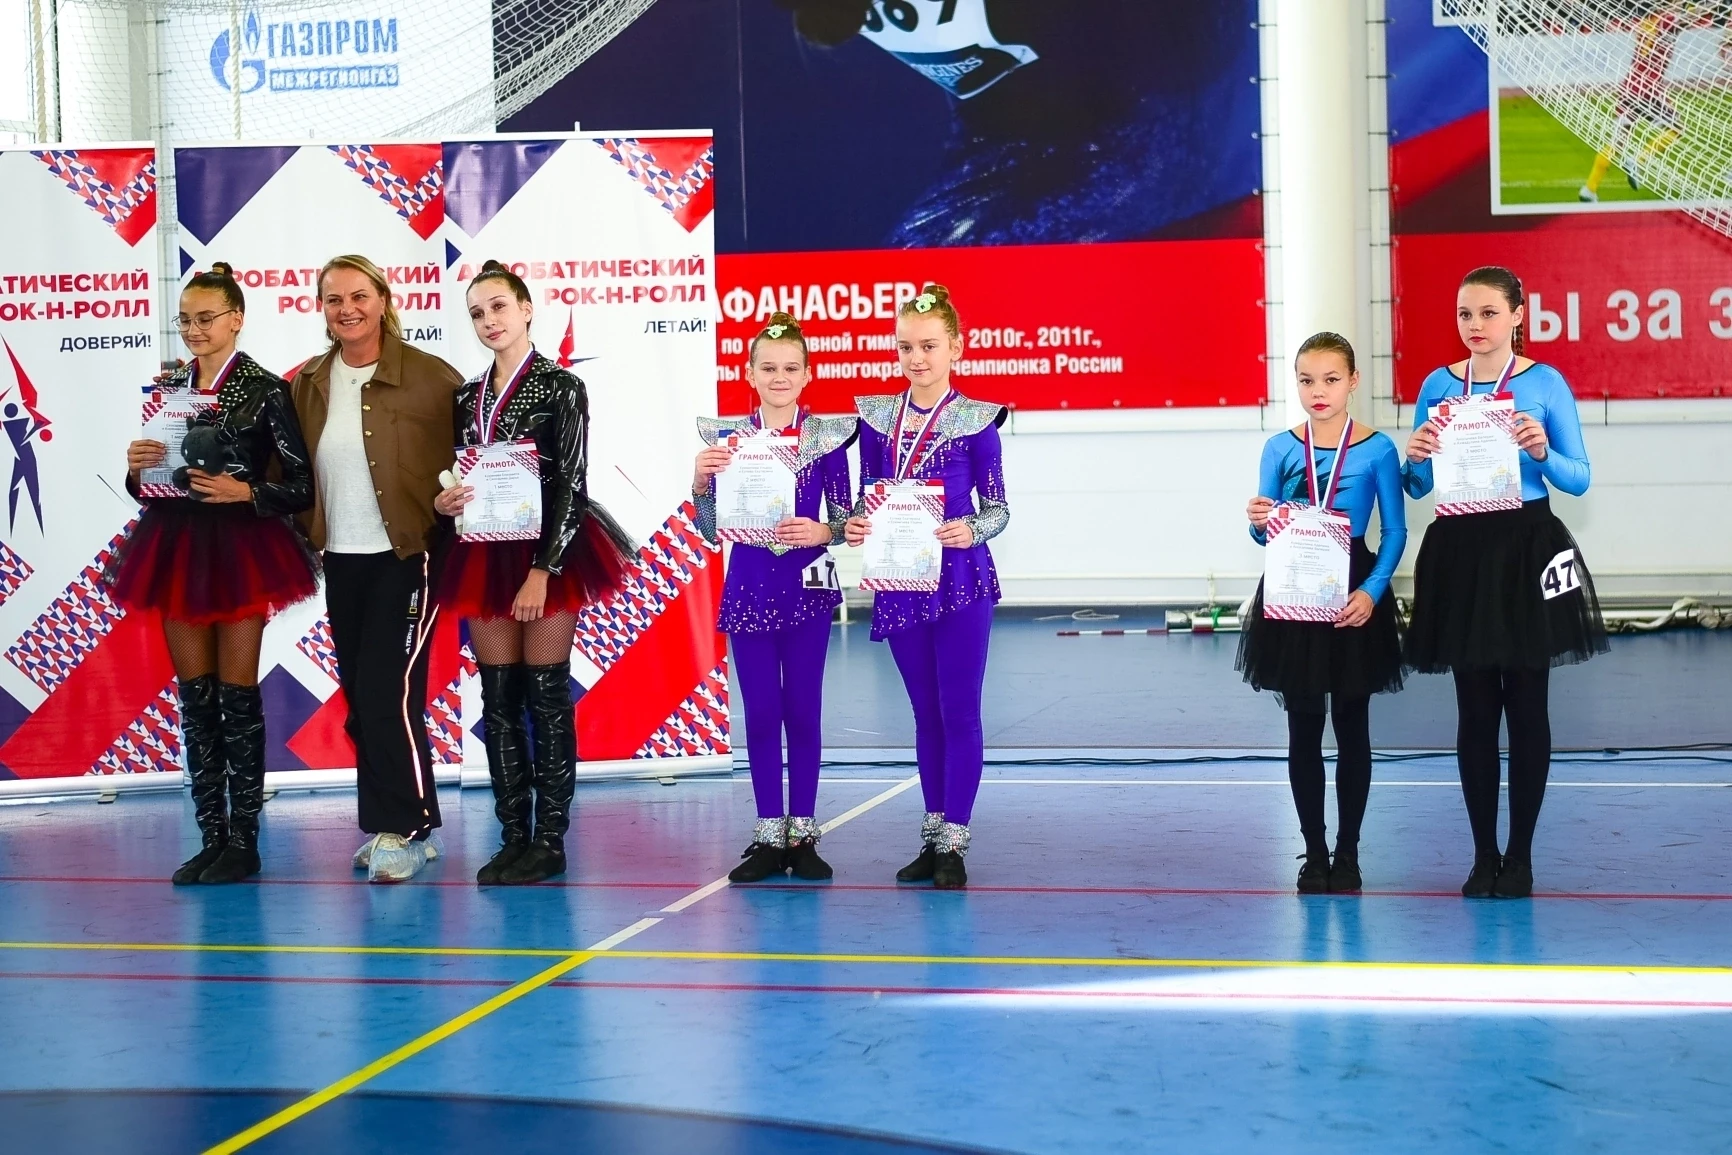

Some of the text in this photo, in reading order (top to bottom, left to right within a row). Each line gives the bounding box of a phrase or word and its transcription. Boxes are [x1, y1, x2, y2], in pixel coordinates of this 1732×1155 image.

[268, 18, 398, 57] ГАЗПРОМ
[271, 67, 398, 90] МЕЖРЕГИОНГАЗ
[457, 255, 705, 281] АОБАТИЧЕСКИЙ
[0, 268, 149, 294] ТИЧЕСКИЙ
[545, 285, 706, 305] РОК-Н-РОЛЛ
[716, 282, 936, 323] ФАНАСЬЕВ
[1606, 288, 1682, 342] за
[403, 325, 442, 341] ТАЙ!
[644, 317, 707, 334] ЛЕТАЙ!
[60, 332, 151, 352] ДОВЕРЯЙ!
[721, 338, 743, 354] по
[816, 361, 903, 382] многокра
[951, 358, 1051, 377] чемпионка
[1055, 353, 1124, 374] России
[163, 411, 197, 419] ГРАМОТА
[1453, 421, 1491, 431] ГРАМОТА
[481, 460, 516, 470] ГРАМОТА
[738, 453, 774, 461] ГРАМОТА
[887, 503, 921, 511] ГРАМОТА
[1290, 528, 1327, 538] ГРАМОТА
[805, 560, 835, 588] 17
[1543, 559, 1574, 594] 47
